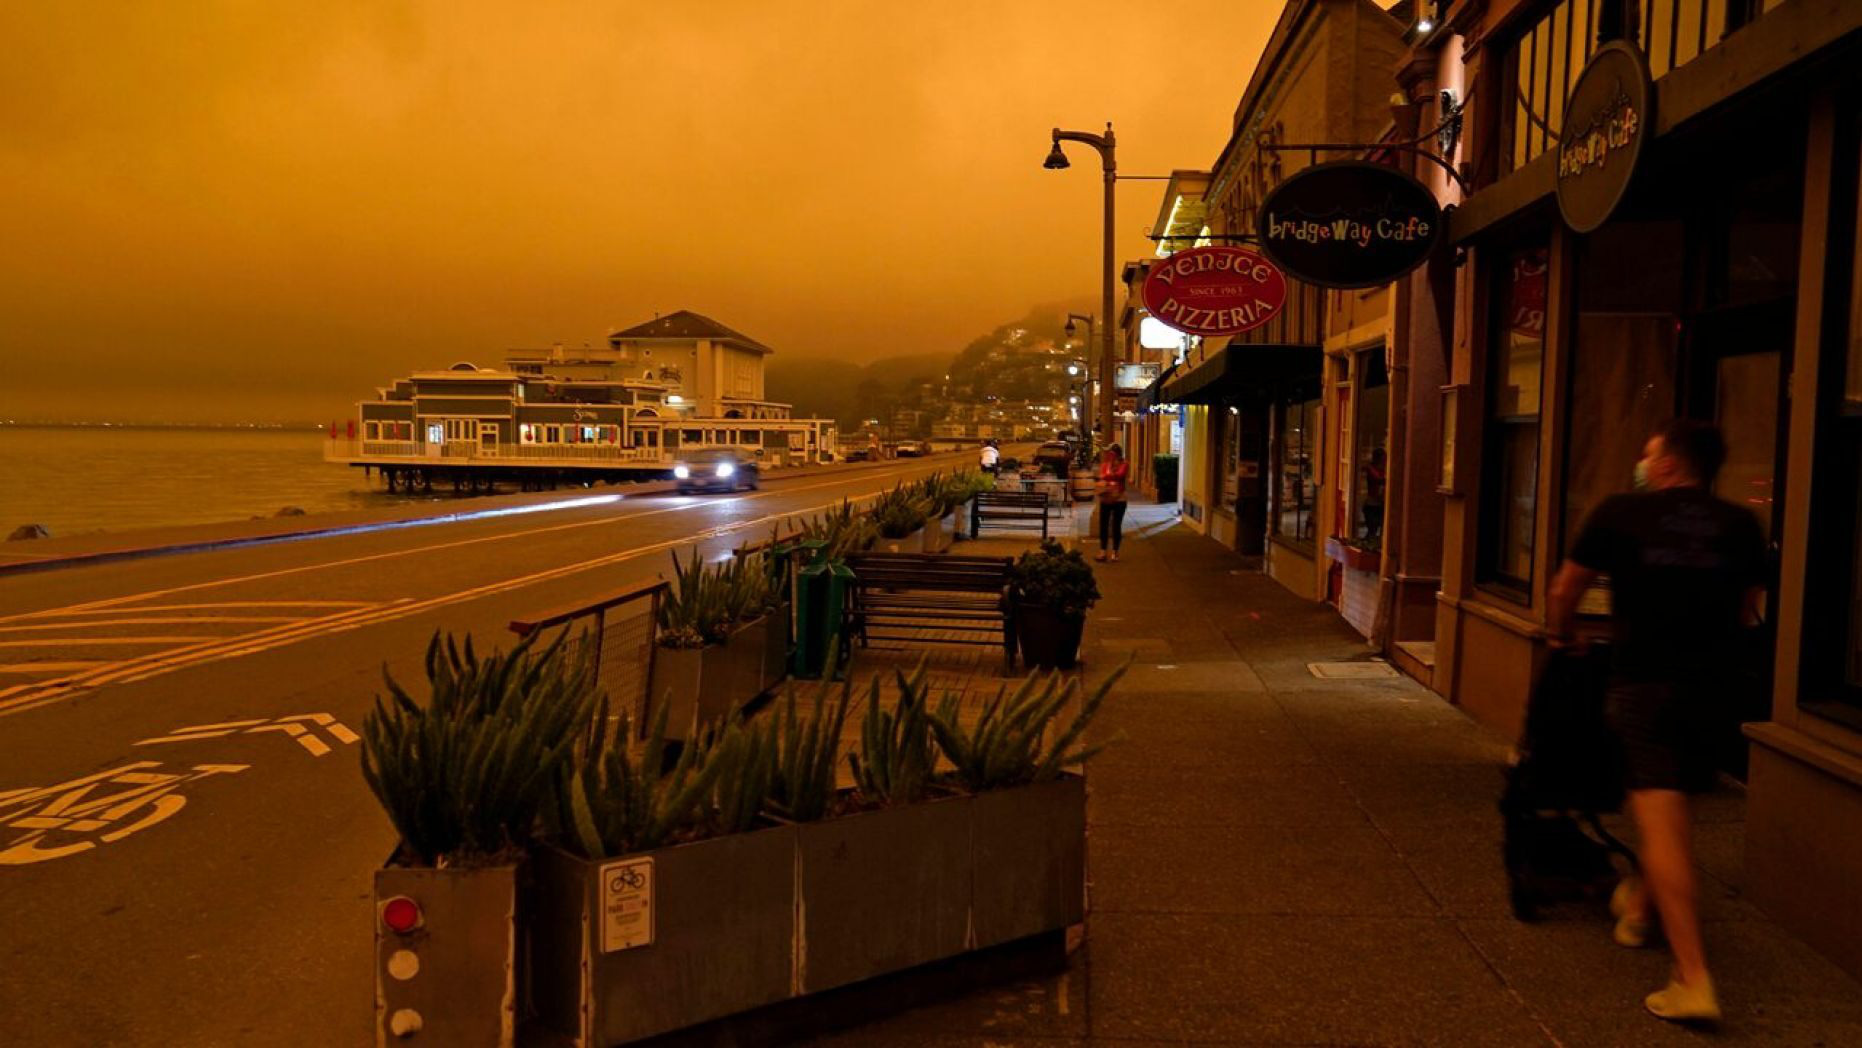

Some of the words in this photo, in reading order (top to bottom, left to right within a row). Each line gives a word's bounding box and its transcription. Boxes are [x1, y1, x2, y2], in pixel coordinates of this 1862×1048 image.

[1609, 107, 1638, 148] Cafe
[1377, 217, 1429, 240] Cafe
[1156, 253, 1272, 285] VENICE
[1190, 287, 1215, 296] SINCE
[1220, 286, 1244, 296] 1963
[1160, 298, 1272, 330] PIZZERIA
